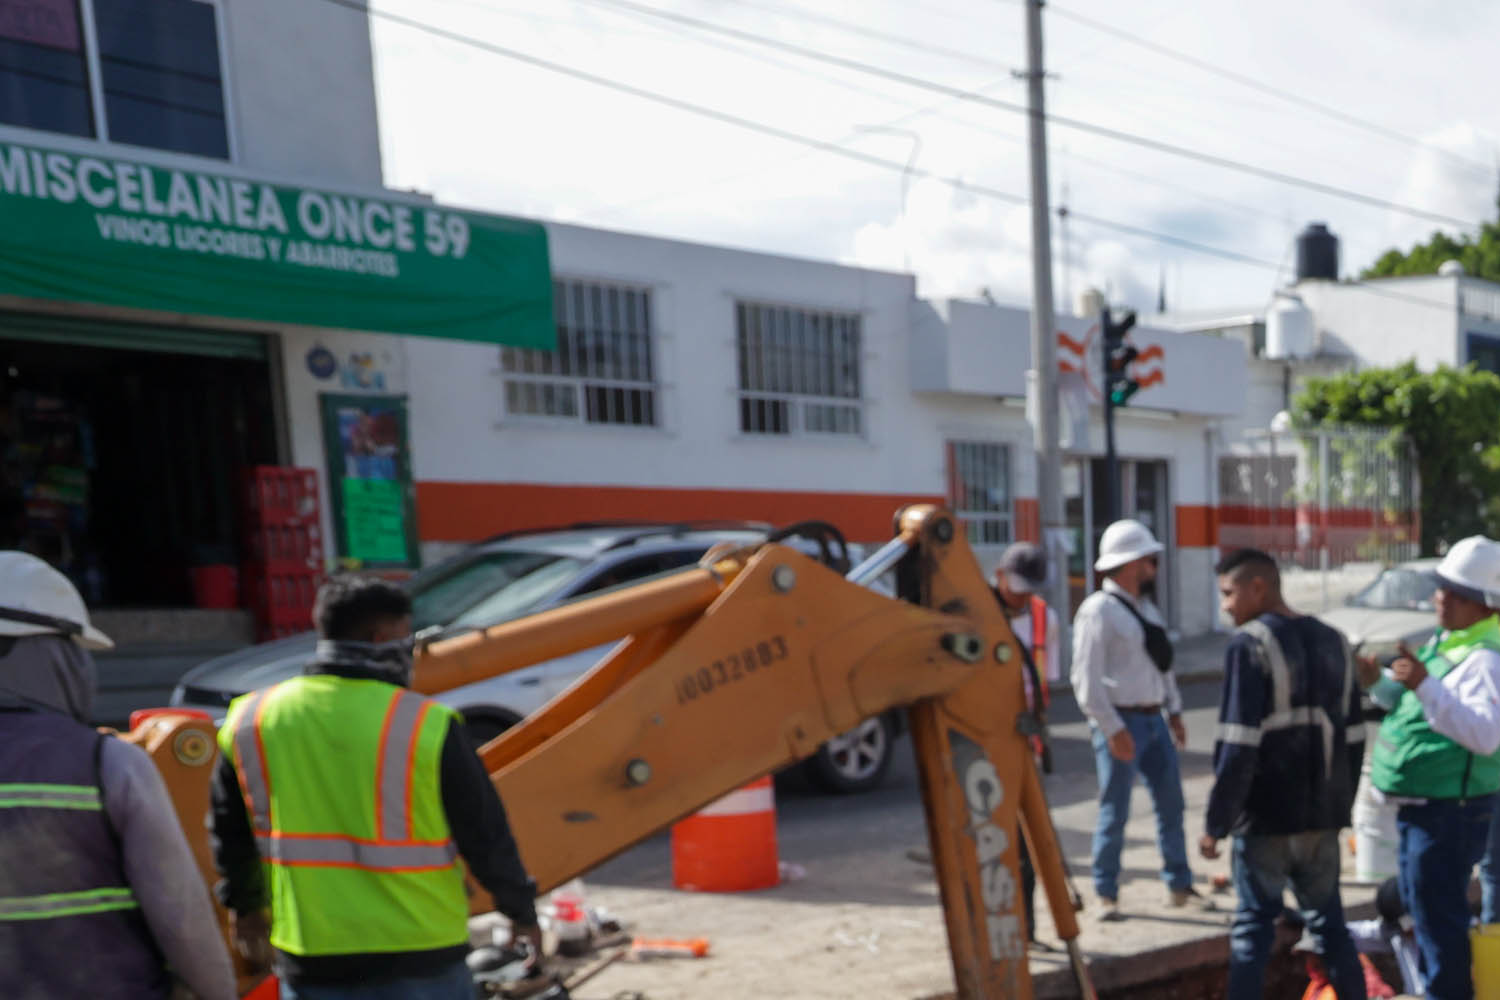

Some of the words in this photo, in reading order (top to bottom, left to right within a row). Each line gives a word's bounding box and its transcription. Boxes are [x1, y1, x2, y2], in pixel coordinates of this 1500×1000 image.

[0, 146, 288, 233] MISCELANEA
[299, 191, 416, 252] ONCE
[423, 211, 470, 259] 59
[95, 213, 170, 247] VINOS
[174, 224, 265, 262] LICORES
[266, 236, 282, 262] Y
[286, 240, 398, 278] ABARROTES
